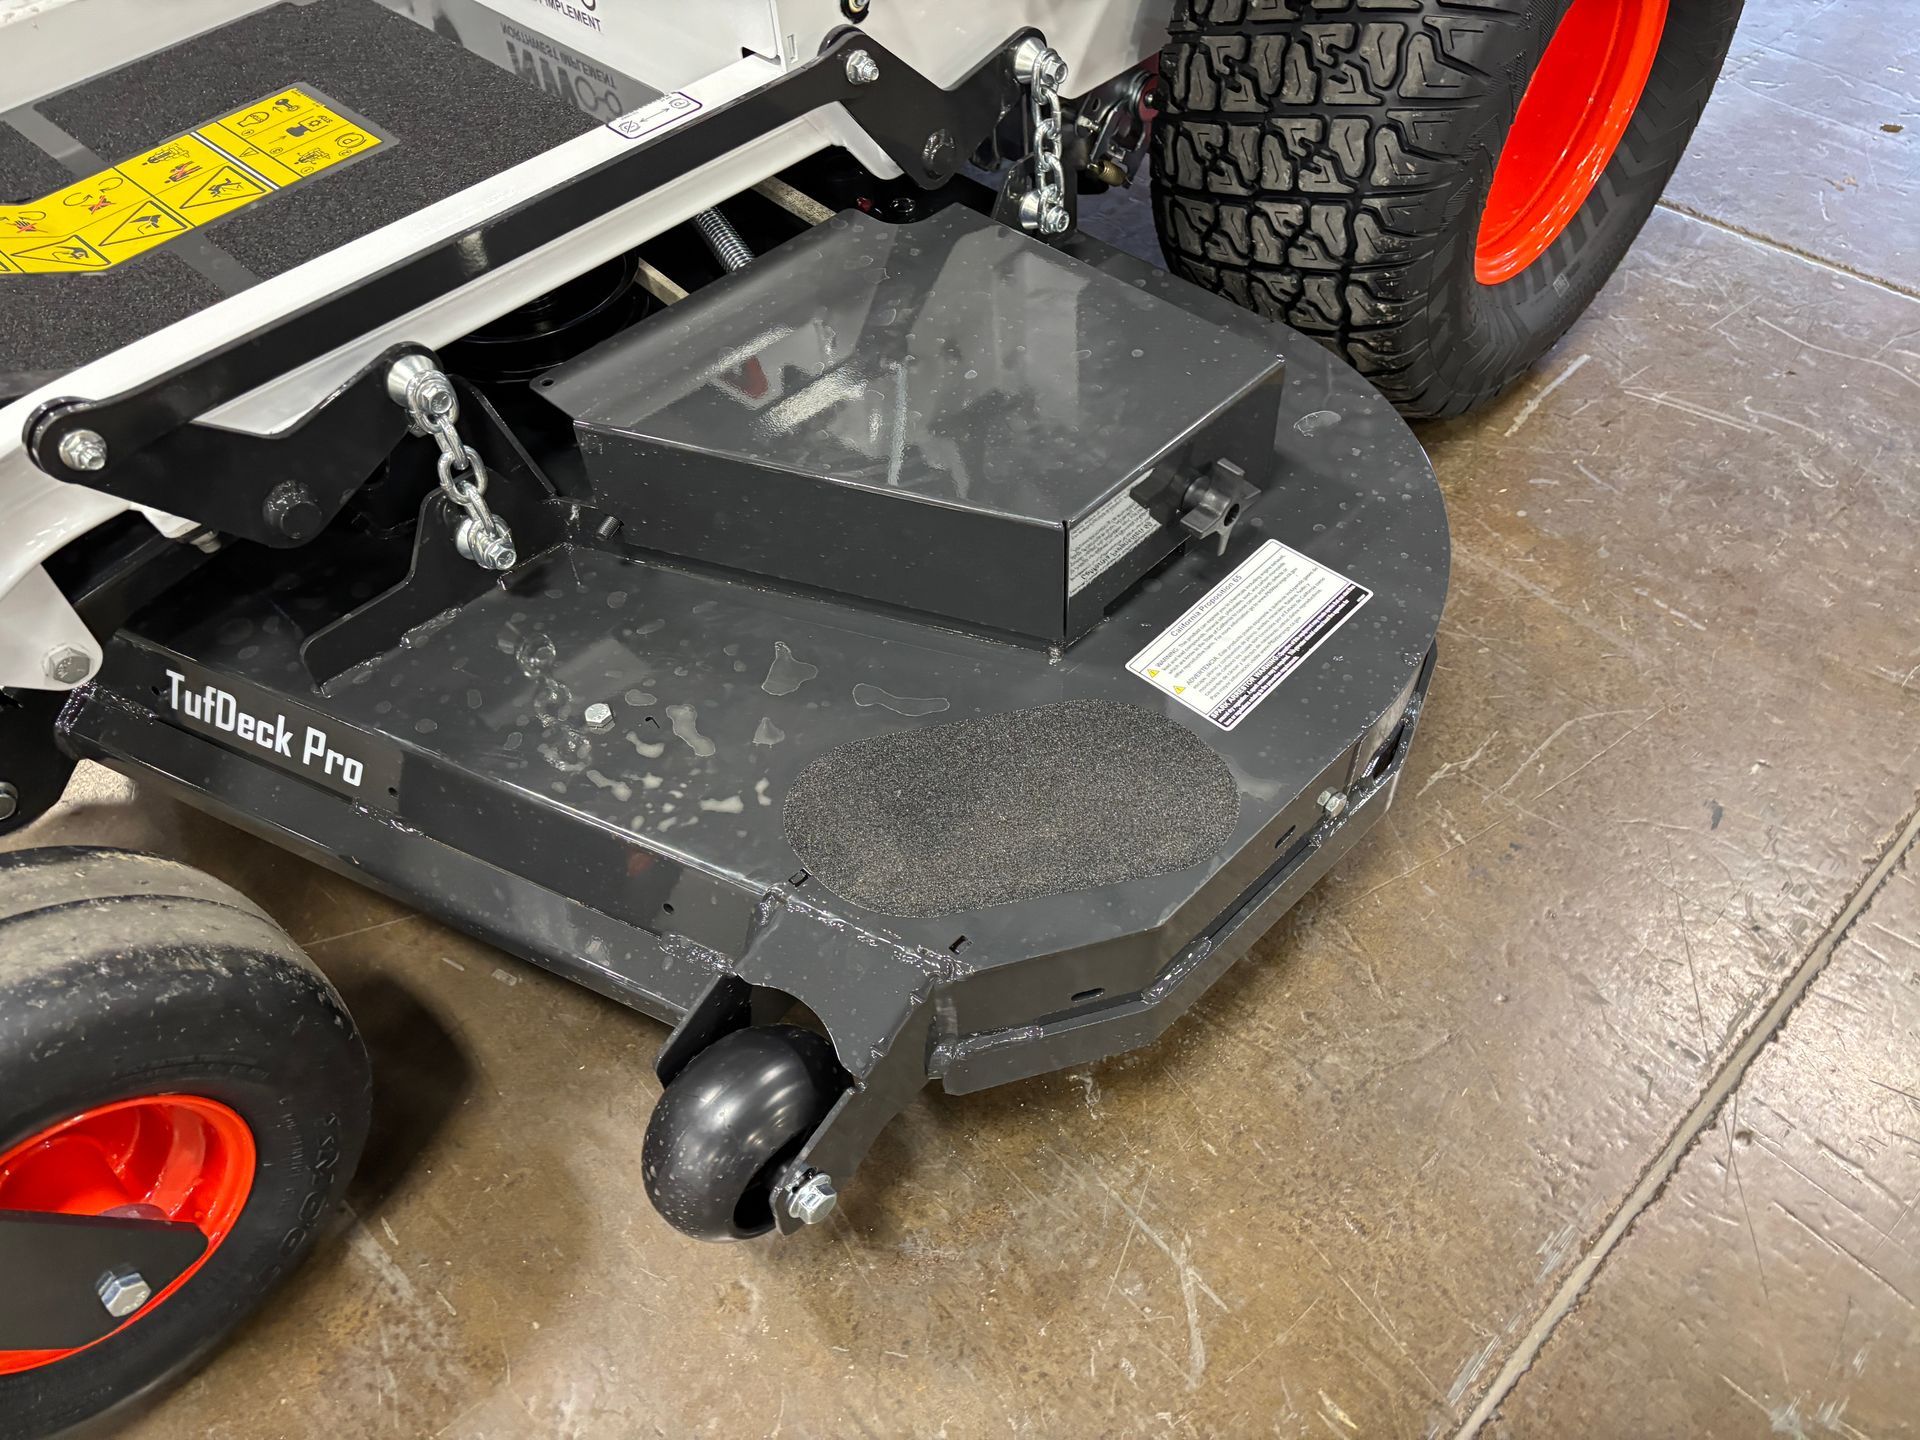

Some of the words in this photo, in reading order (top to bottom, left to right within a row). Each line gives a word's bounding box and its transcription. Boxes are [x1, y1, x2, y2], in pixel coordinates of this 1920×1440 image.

[546, 0, 601, 31] IMPLEMENT
[1170, 611, 1202, 637] California
[1198, 582, 1235, 612] Proposition
[1231, 574, 1243, 583] 65
[1211, 700, 1231, 718] SPARK
[1226, 676, 1257, 703] ARRESTOR
[166, 669, 294, 758] TufDeck
[302, 726, 364, 787] Pro
